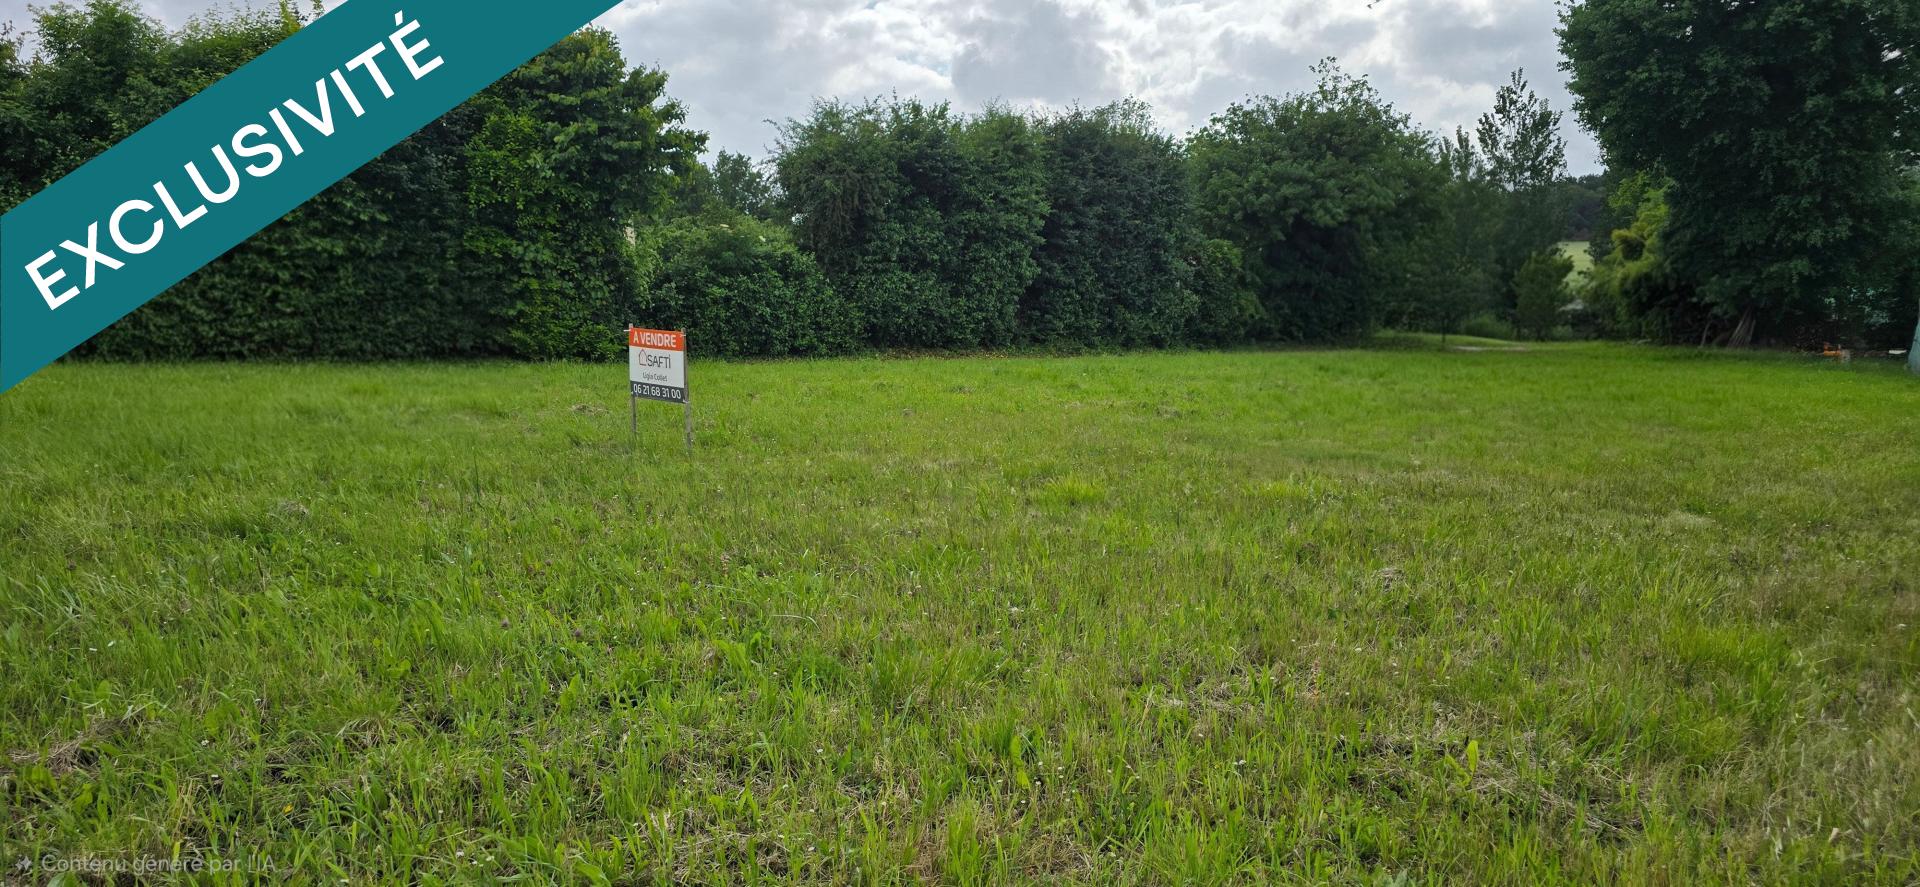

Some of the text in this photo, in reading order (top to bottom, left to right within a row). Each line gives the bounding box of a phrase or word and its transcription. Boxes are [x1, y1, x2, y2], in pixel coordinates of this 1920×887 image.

[633, 330, 676, 347] A VENDRE
[633, 383, 681, 399] 06 21 68 31 00
